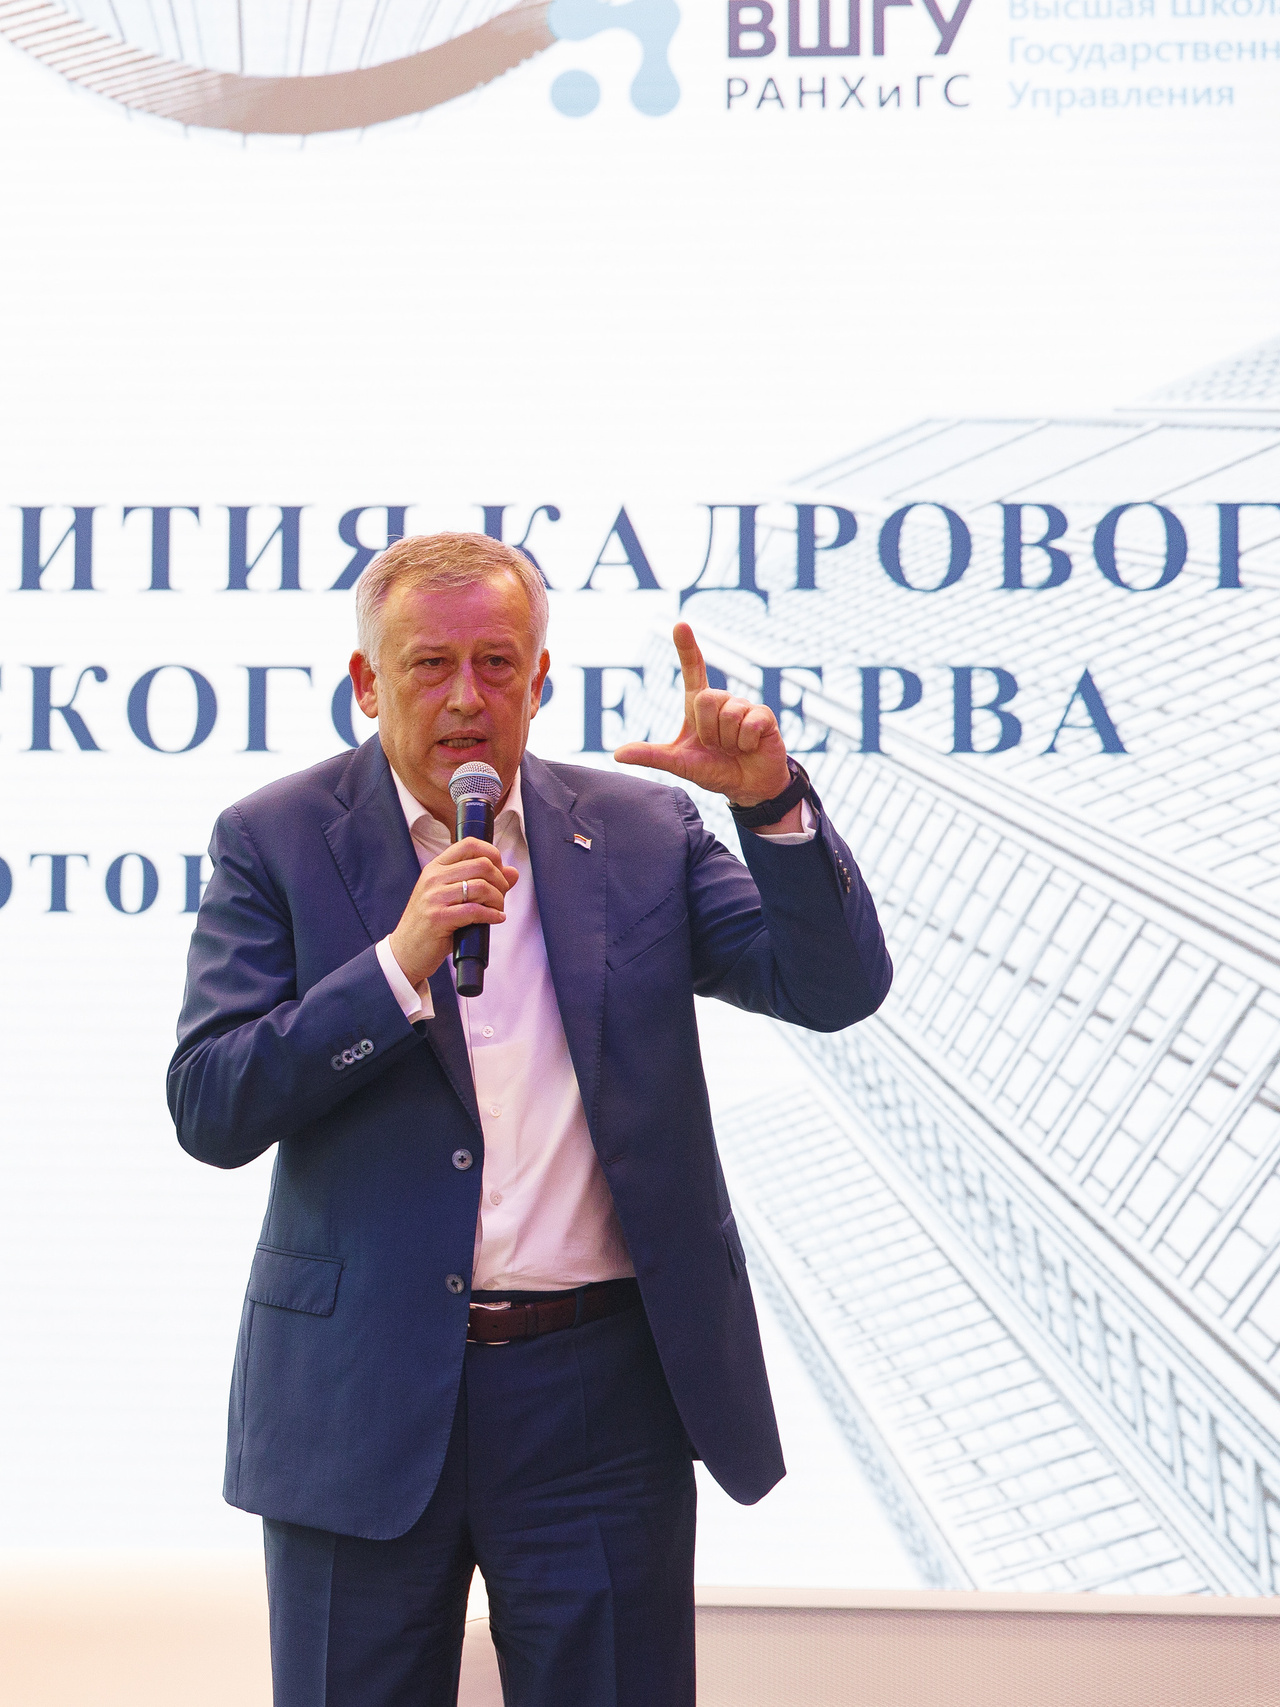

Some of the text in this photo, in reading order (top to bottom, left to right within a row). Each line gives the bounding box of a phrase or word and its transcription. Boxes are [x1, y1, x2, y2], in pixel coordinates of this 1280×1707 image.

[1009, 0, 1280, 20] Высшая Школ
[727, 0, 973, 59] ВШГУ
[1009, 36, 1280, 73] Государственн
[726, 74, 970, 109] РАНХиГС
[1008, 81, 1236, 117] Управления
[530, 664, 1131, 756] ЕЕРВА
